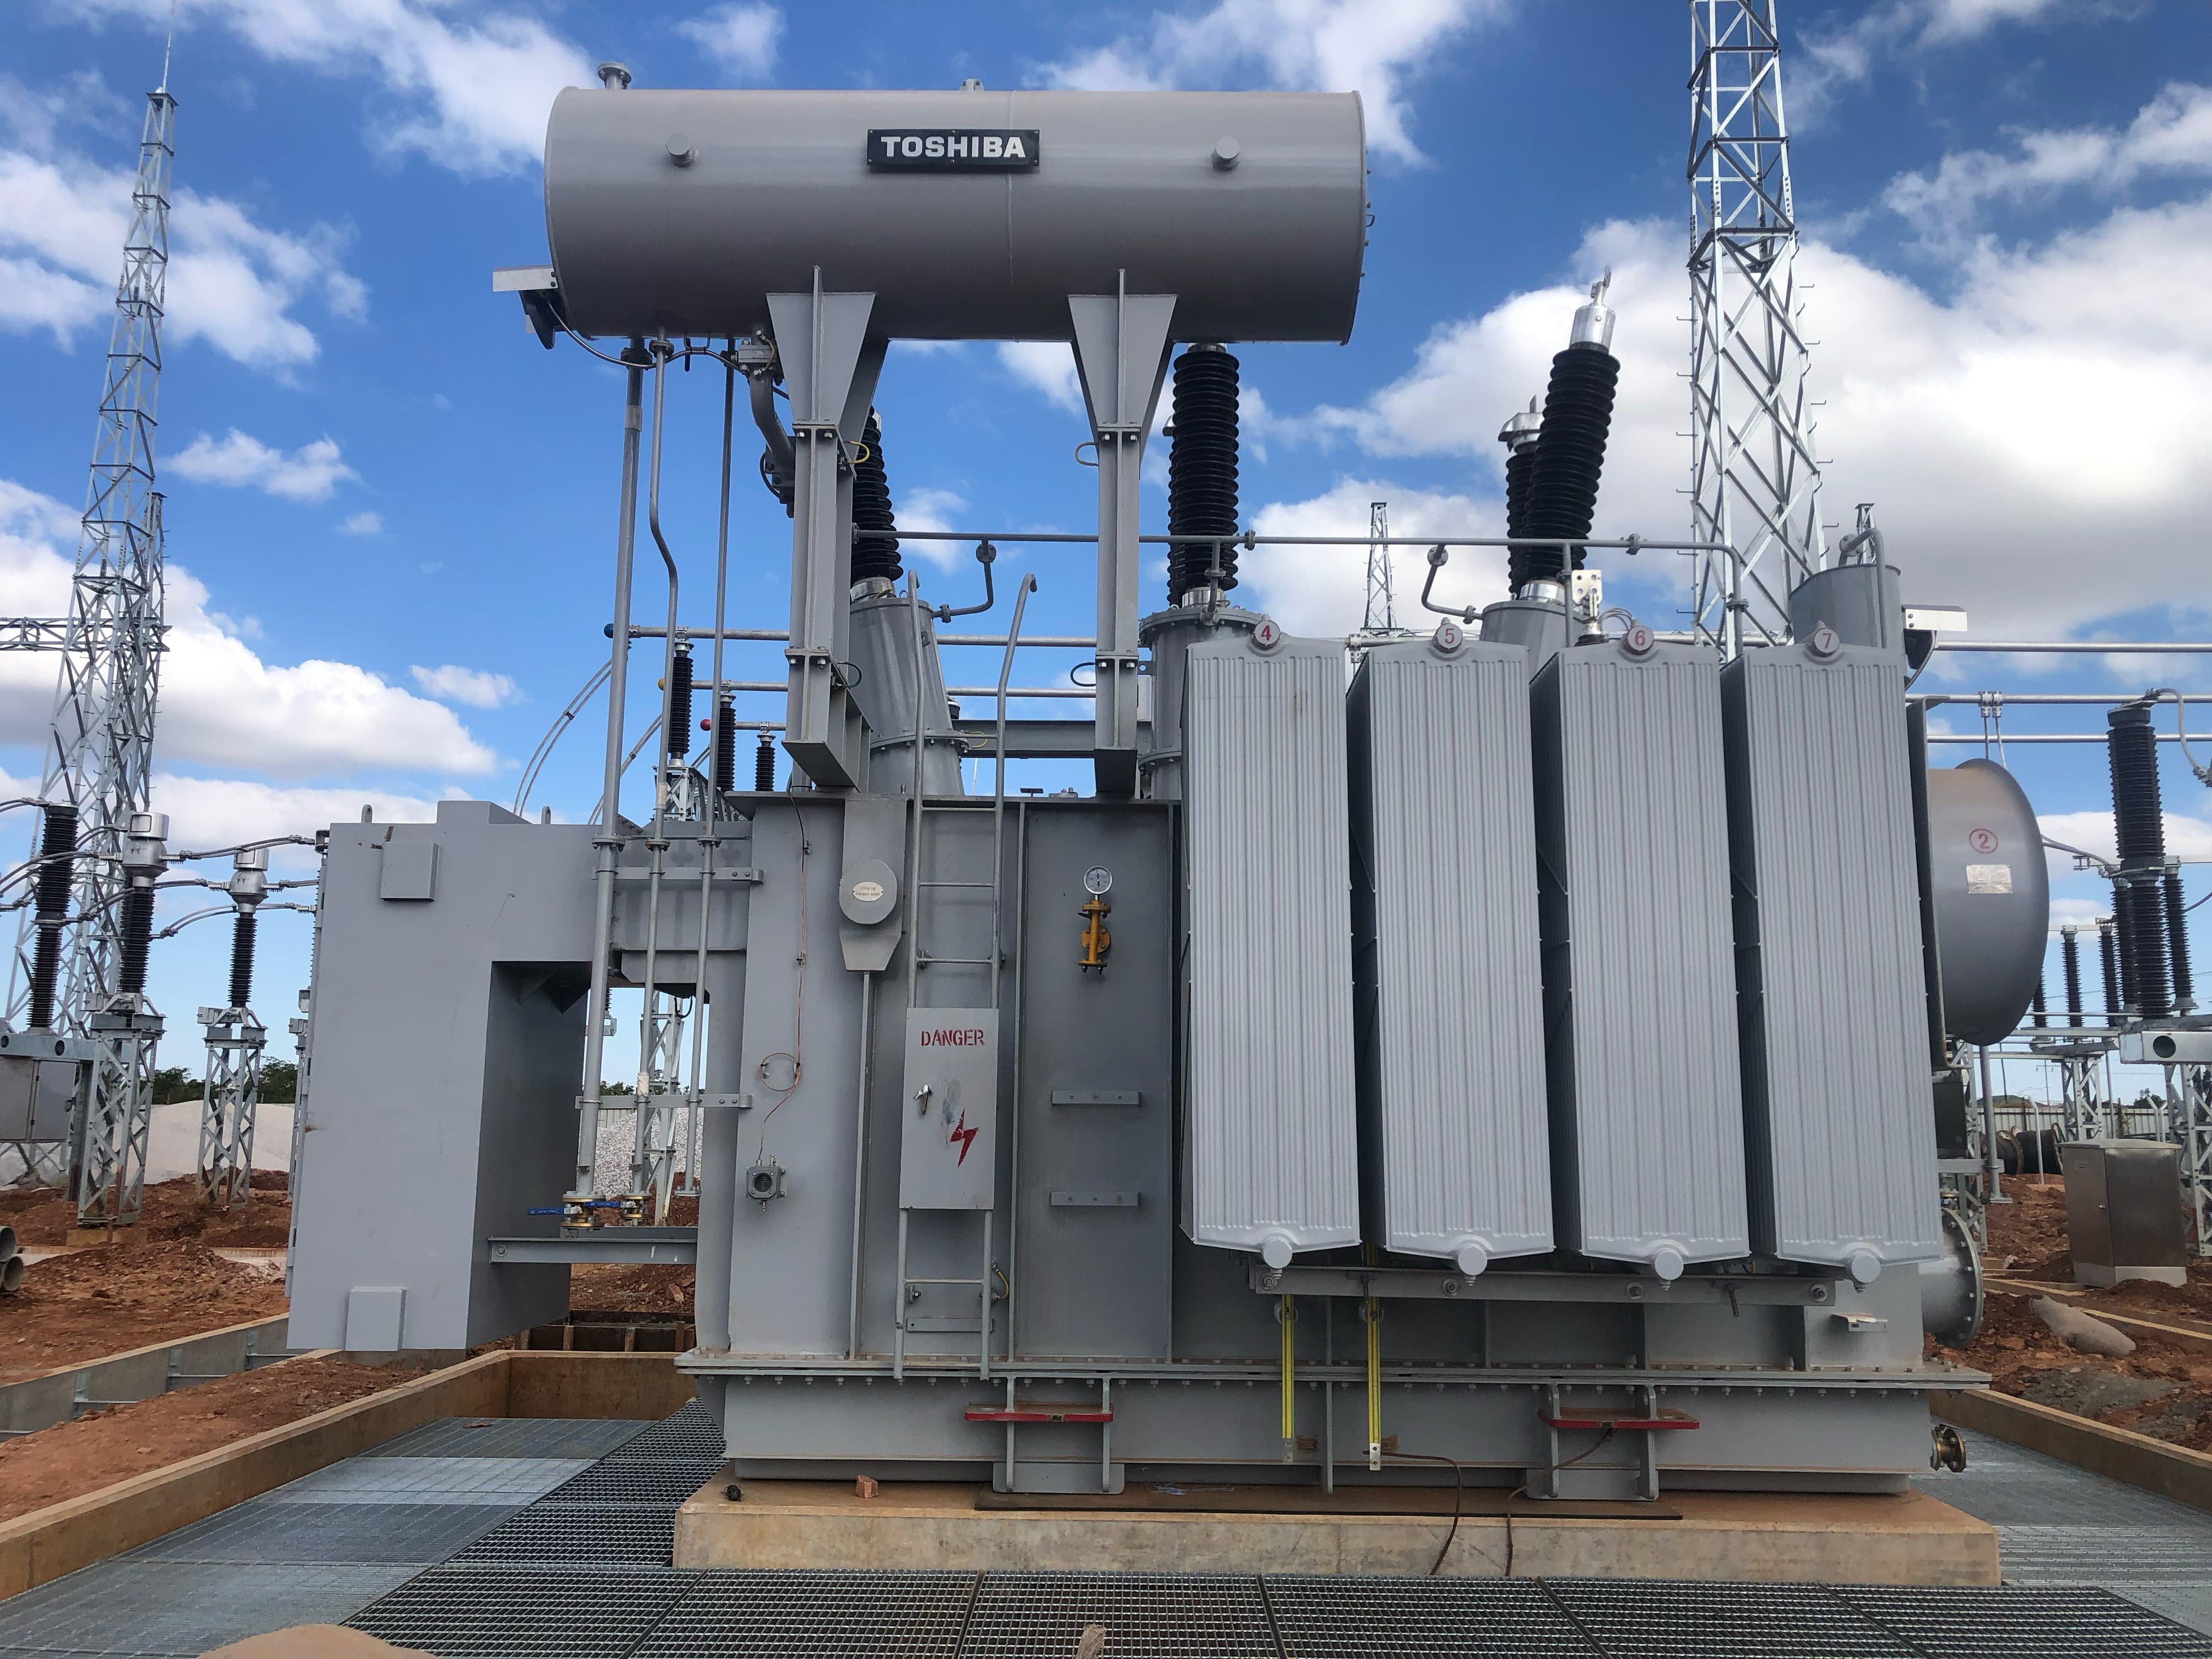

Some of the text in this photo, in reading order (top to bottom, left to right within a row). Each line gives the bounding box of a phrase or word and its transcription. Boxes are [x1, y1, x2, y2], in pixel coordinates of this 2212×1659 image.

[881, 136, 1026, 158] TOSHIBA
[1260, 624, 1272, 641] 4
[1444, 628, 1455, 644] 5
[1634, 629, 1646, 646] 6
[1822, 632, 1832, 648] 7
[1978, 833, 1991, 849] 2
[921, 1029, 985, 1046] DANGER
